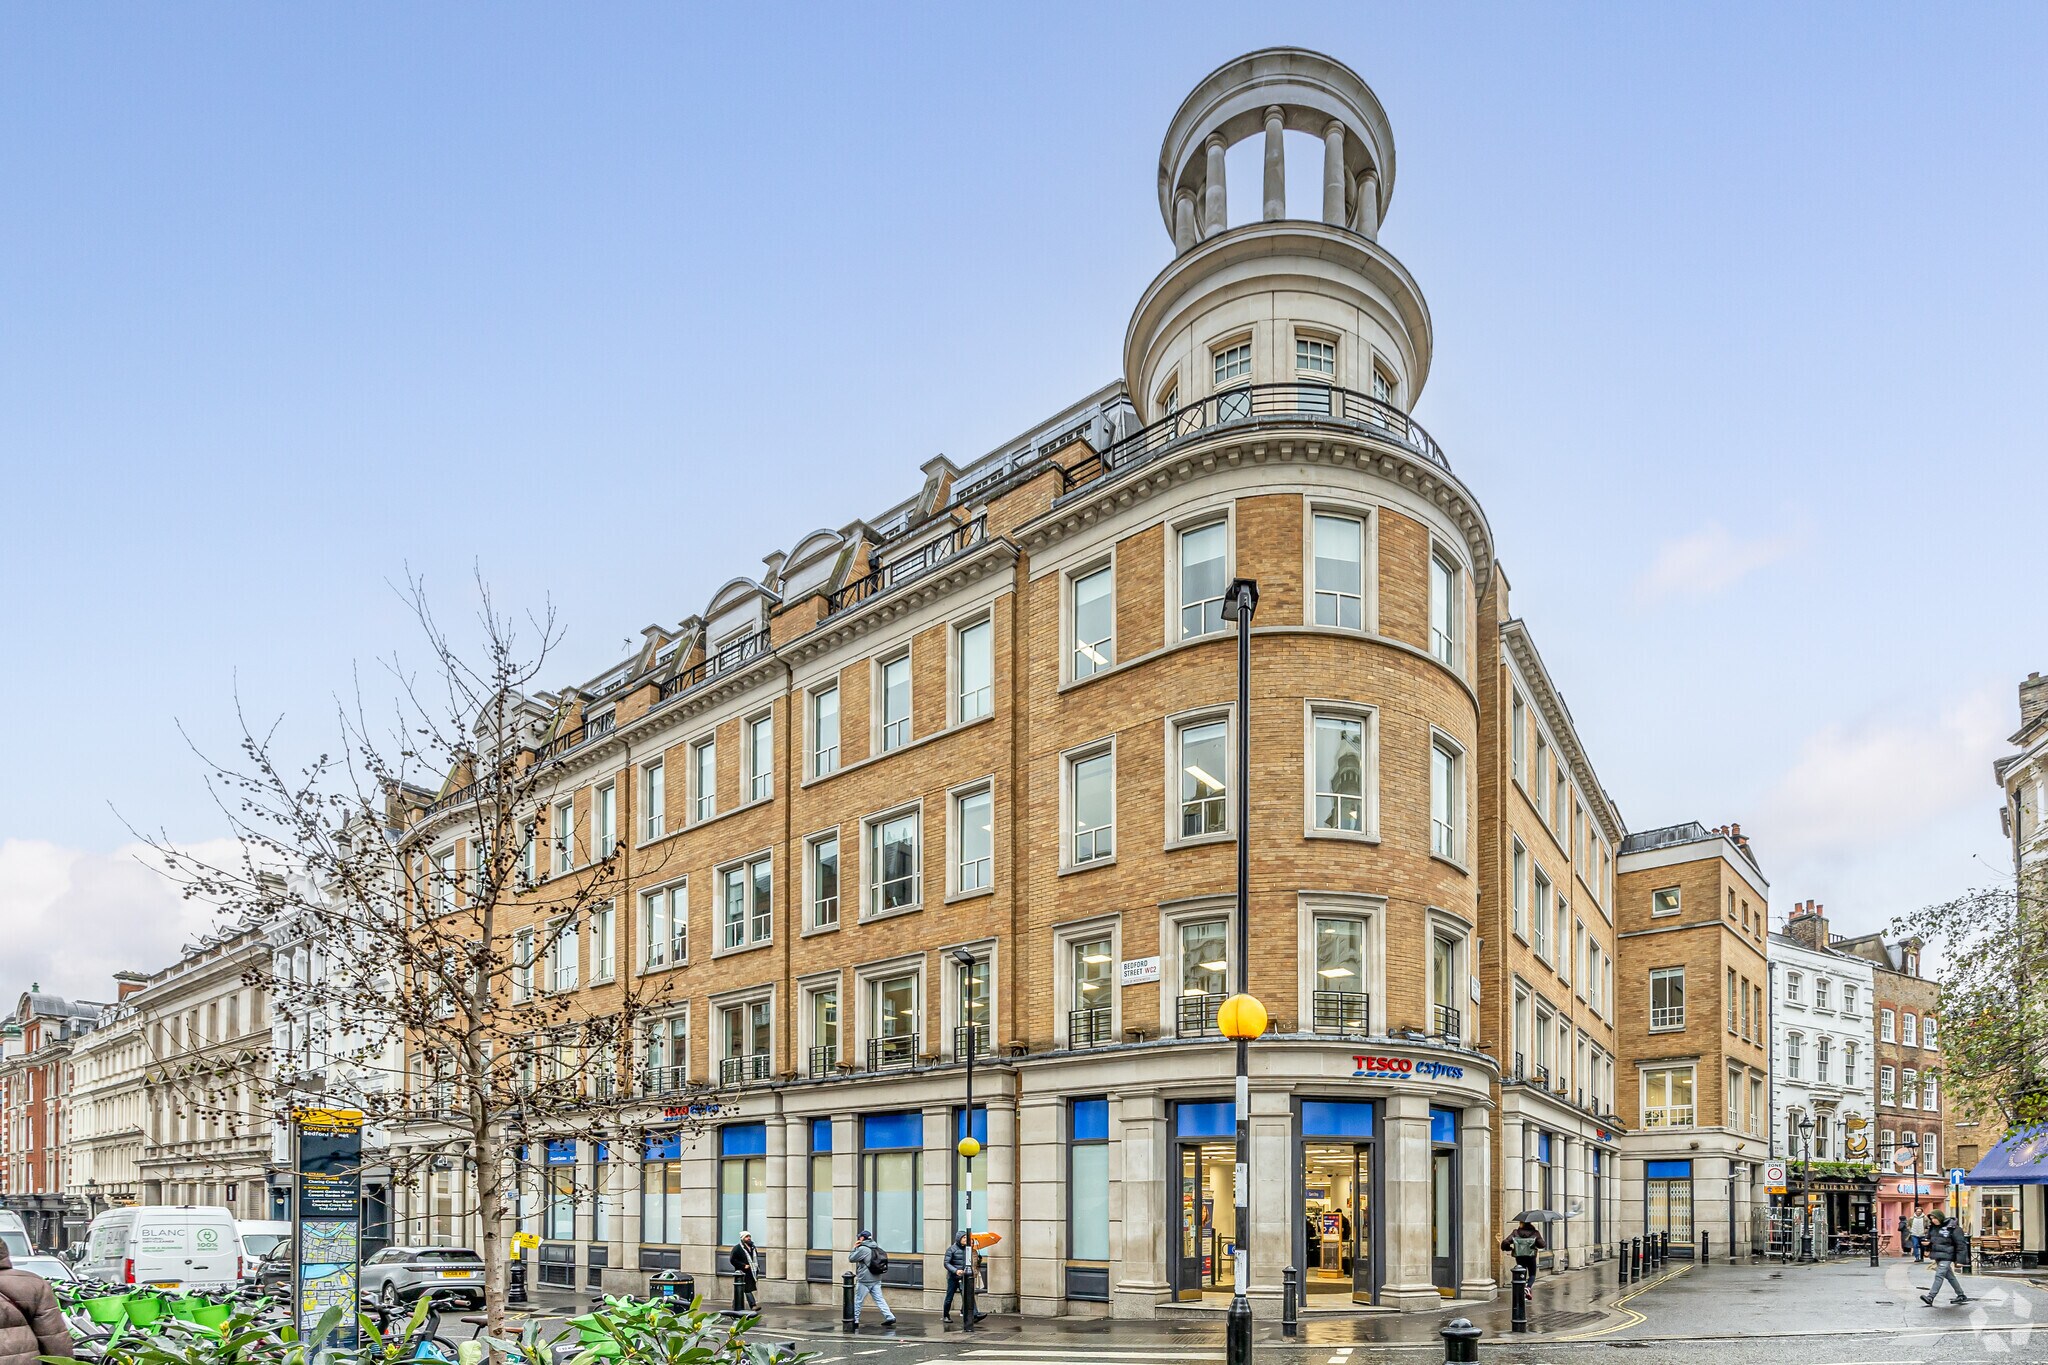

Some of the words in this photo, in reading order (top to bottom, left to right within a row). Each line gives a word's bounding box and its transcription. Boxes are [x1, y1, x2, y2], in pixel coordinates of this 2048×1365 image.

[1124, 960, 1148, 970] BEDFORD
[1124, 968, 1143, 977] STREET
[1353, 1056, 1412, 1072] TESCO
[1416, 1061, 1463, 1079] express
